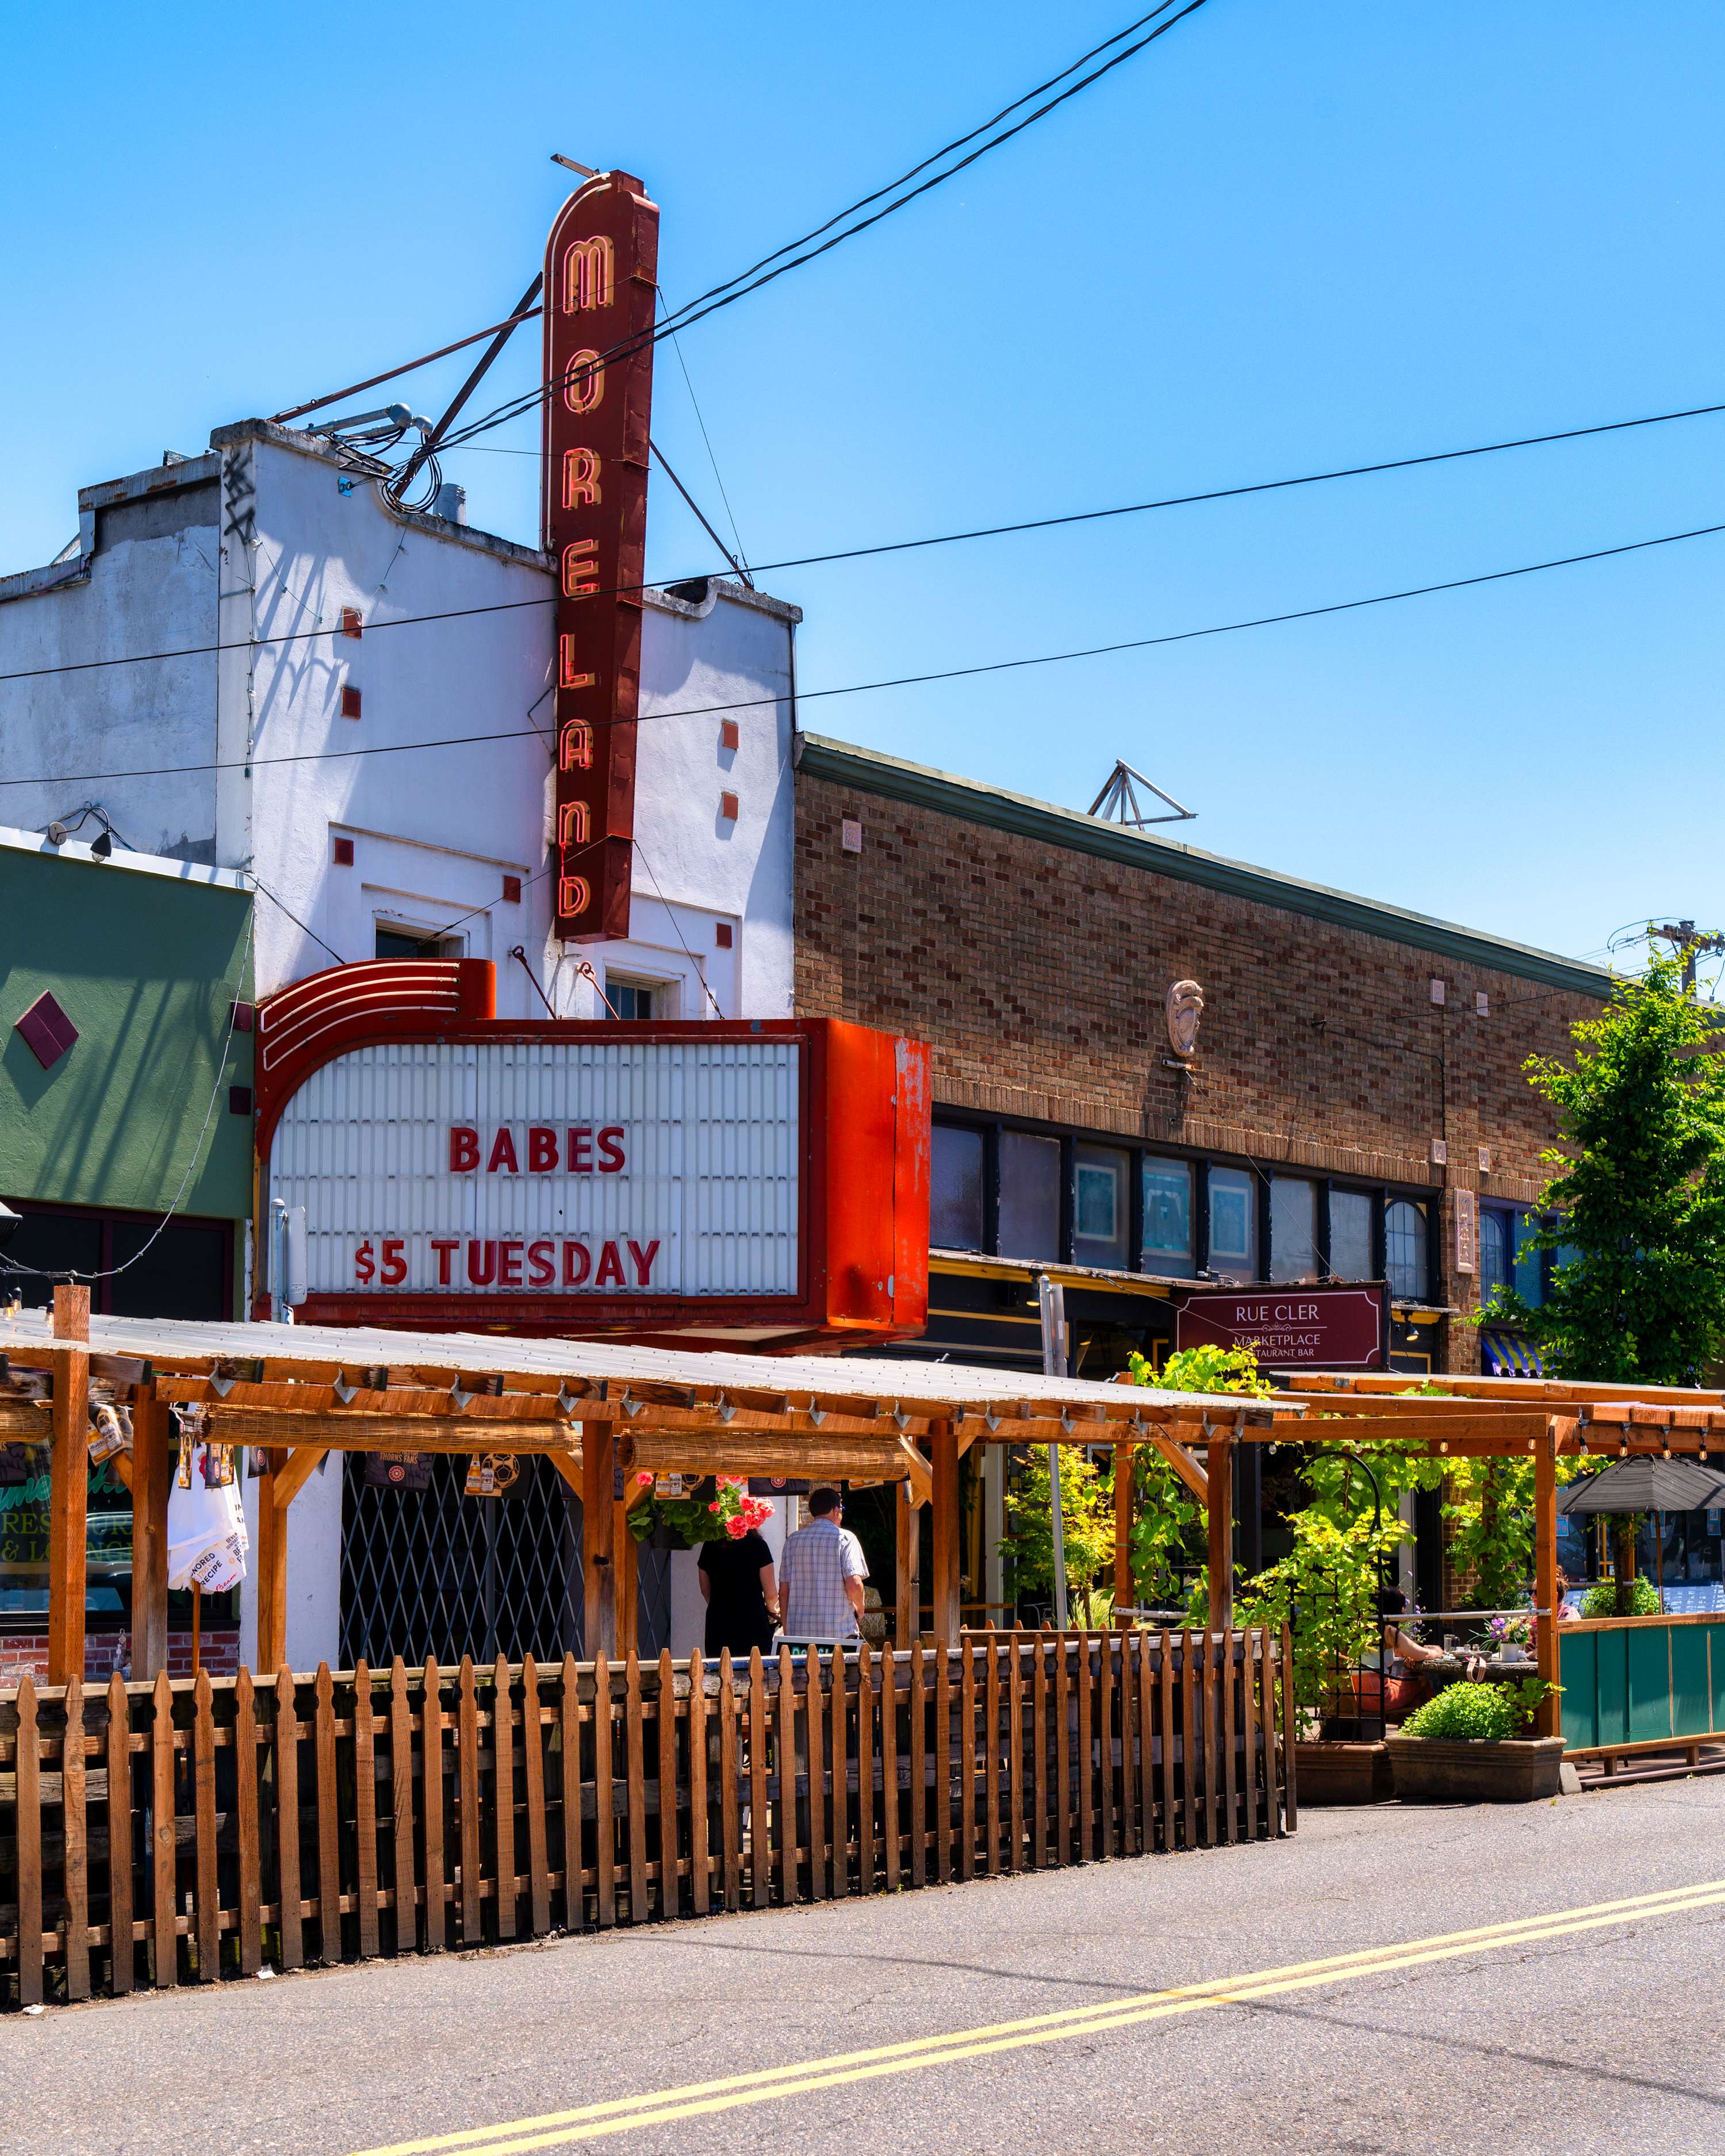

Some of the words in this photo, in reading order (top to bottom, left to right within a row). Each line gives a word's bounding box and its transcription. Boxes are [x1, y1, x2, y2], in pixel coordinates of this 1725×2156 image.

[450, 1126, 626, 1173] BABES
[355, 1240, 408, 1285] $5
[431, 1240, 661, 1286] TUESDAY
[1236, 1306, 1269, 1322] RUE
[1275, 1305, 1320, 1321] CLER
[1235, 1334, 1320, 1346] MARKETPLACE
[1245, 1348, 1295, 1357] STAURANT
[1298, 1348, 1314, 1357] BAR
[380, 1452, 402, 1463] THORNS
[404, 1455, 419, 1464] FANS
[2, 1540, 19, 1562] &
[200, 1560, 223, 1586] RECIPE
